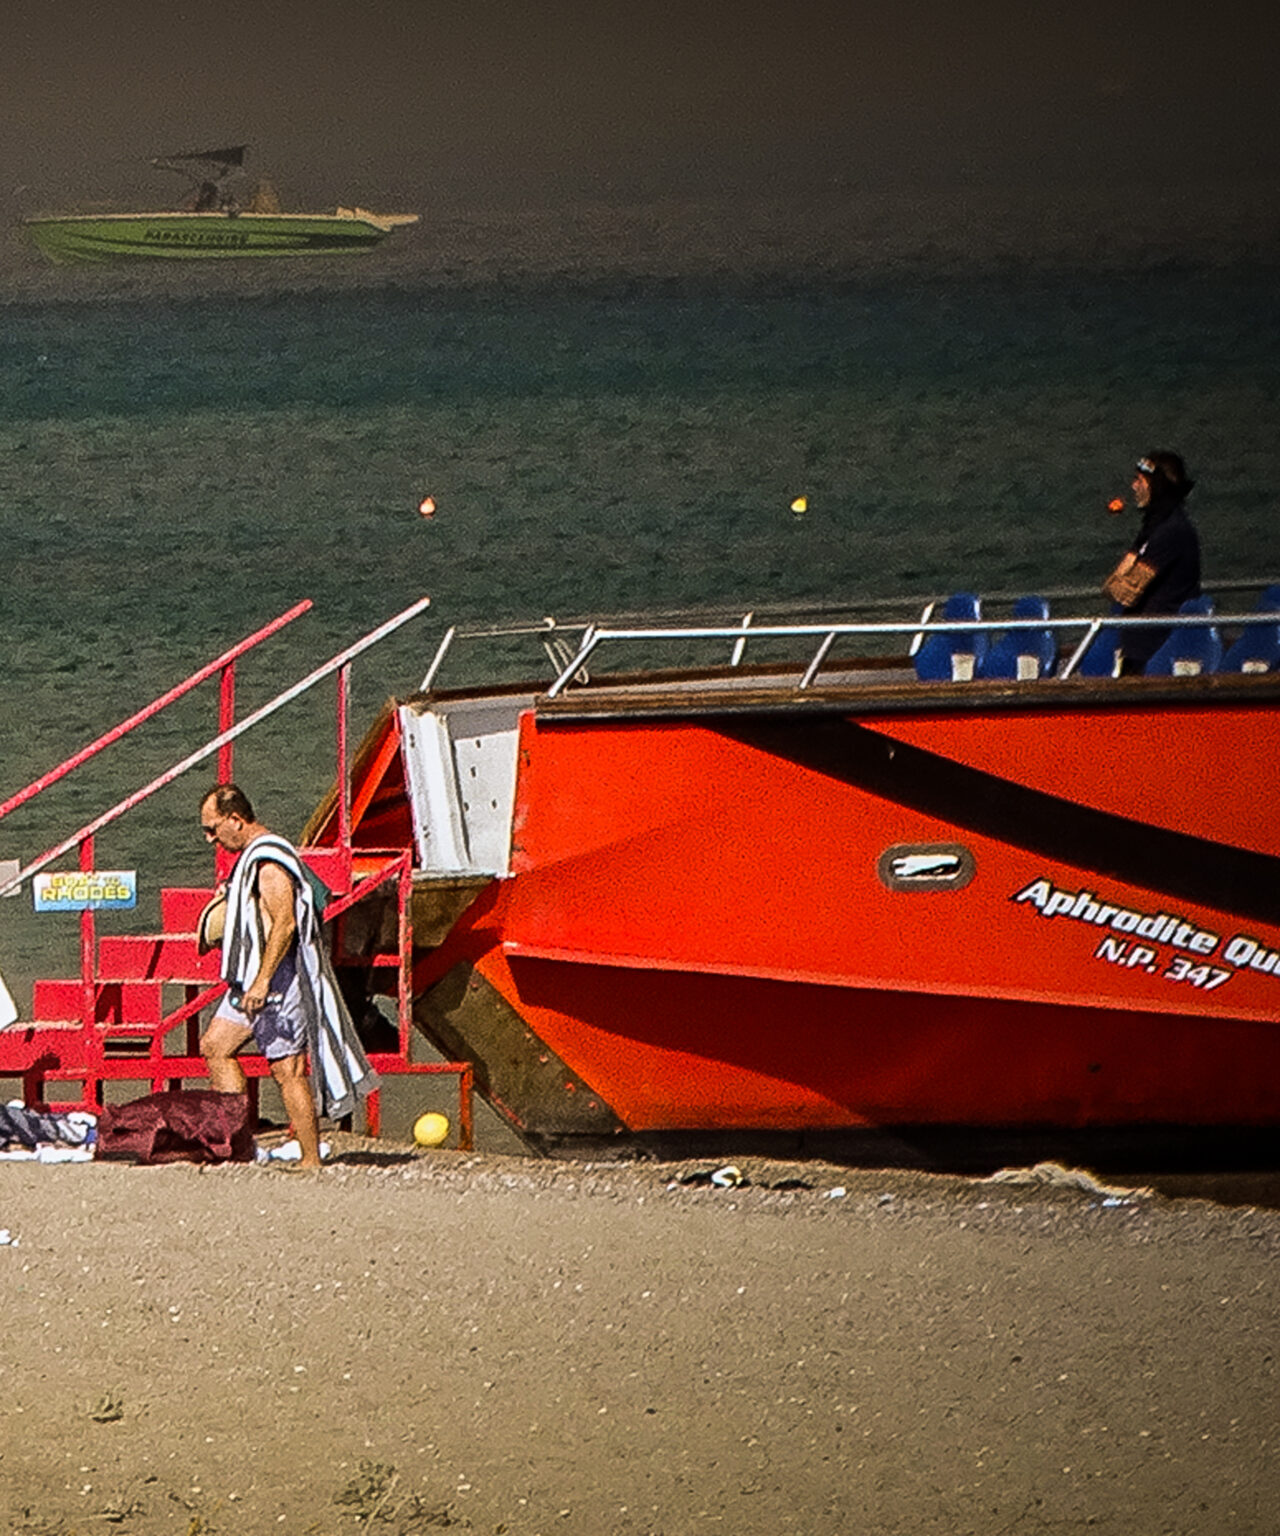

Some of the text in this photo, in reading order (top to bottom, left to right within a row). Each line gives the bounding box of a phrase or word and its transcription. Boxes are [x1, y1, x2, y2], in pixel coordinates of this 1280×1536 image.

[41, 886, 132, 901] RHODES
[1013, 878, 1220, 954] Aphrodite
[1095, 937, 1232, 991] N.P. 347
